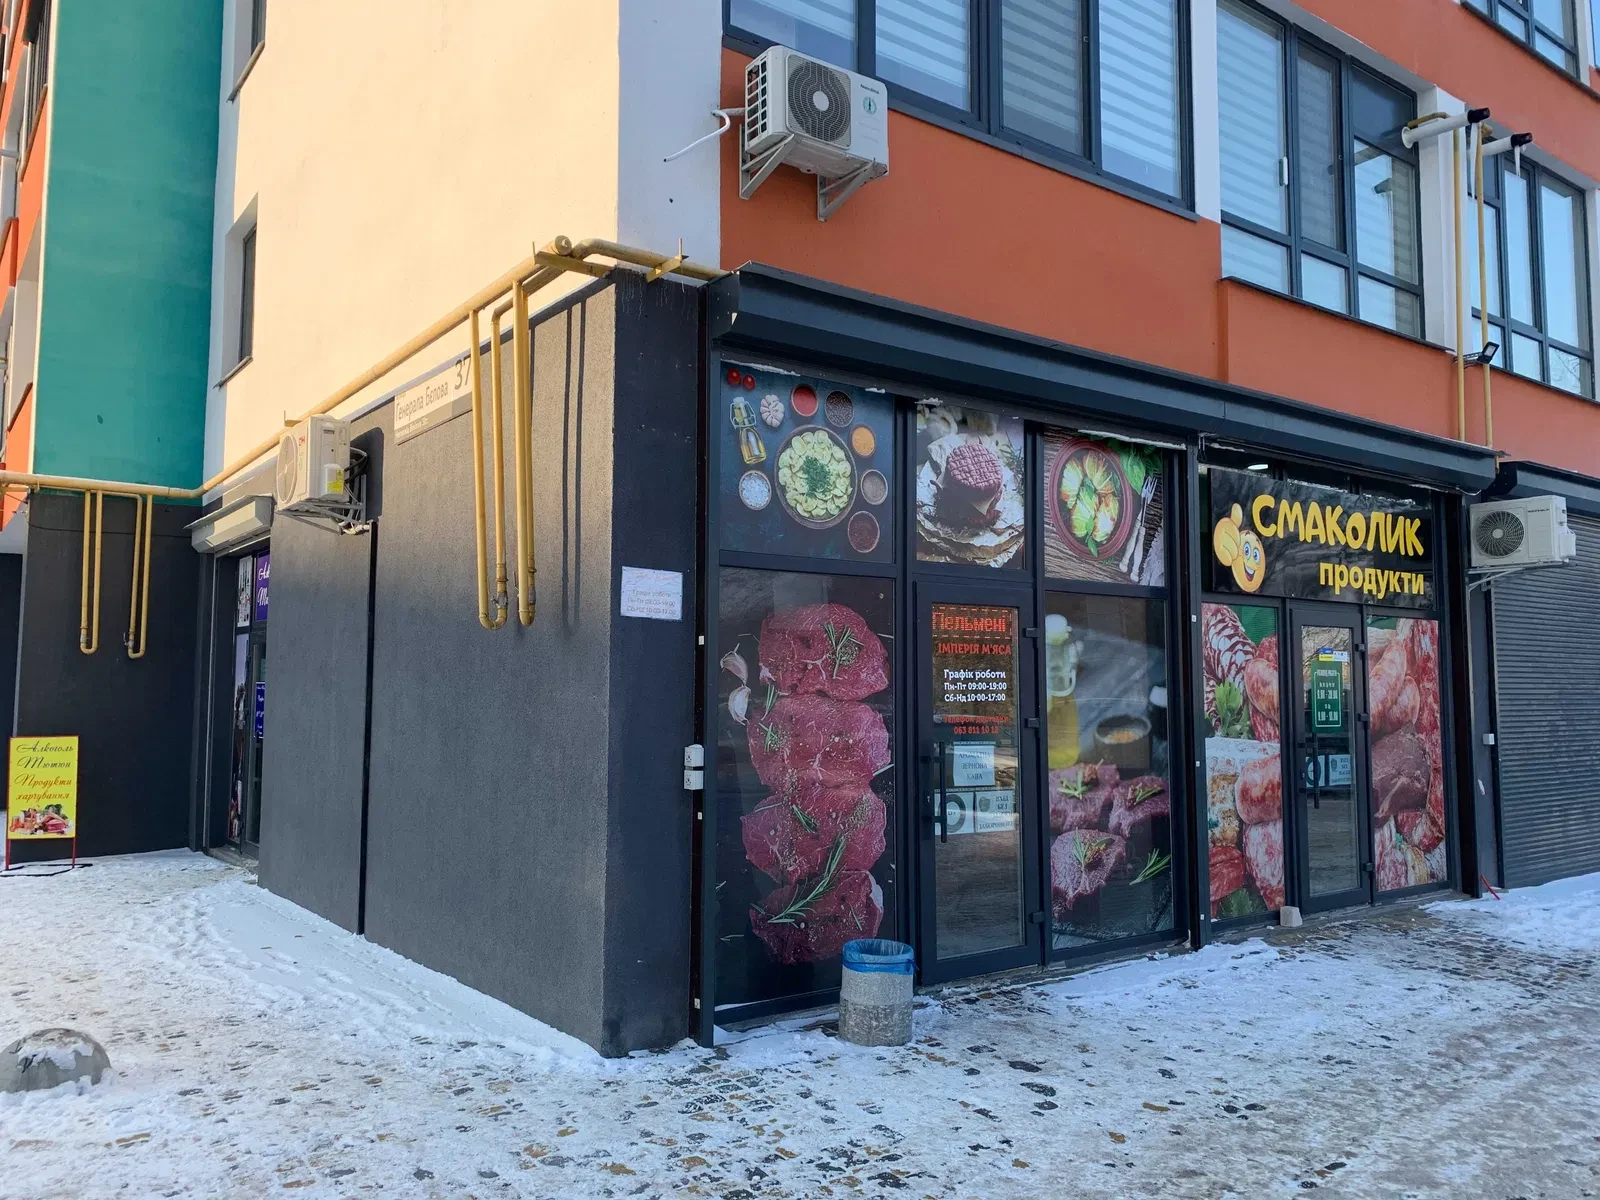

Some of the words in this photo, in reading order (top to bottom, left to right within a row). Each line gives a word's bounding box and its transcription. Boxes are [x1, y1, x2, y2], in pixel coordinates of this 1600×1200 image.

[396, 395, 424, 421] Генерала
[1252, 494, 1424, 557] СМАКОЛИК
[1319, 562, 1424, 599] продукти
[932, 612, 1006, 632] Пельмені
[938, 643, 979, 654] ІМПЕРІЯ
[981, 644, 1011, 655] М'ЯСА
[944, 669, 973, 680] Графік
[975, 669, 1006, 680] роботи
[968, 682, 1007, 690] 09:00-19:00
[944, 693, 966, 702] Сб-Нд
[967, 693, 1006, 701] 10:00-17:00
[16, 740, 73, 753] Алкоголь
[17, 756, 71, 768] Тютюн
[14, 773, 72, 788] Продукти
[16, 790, 70, 803] харчування
